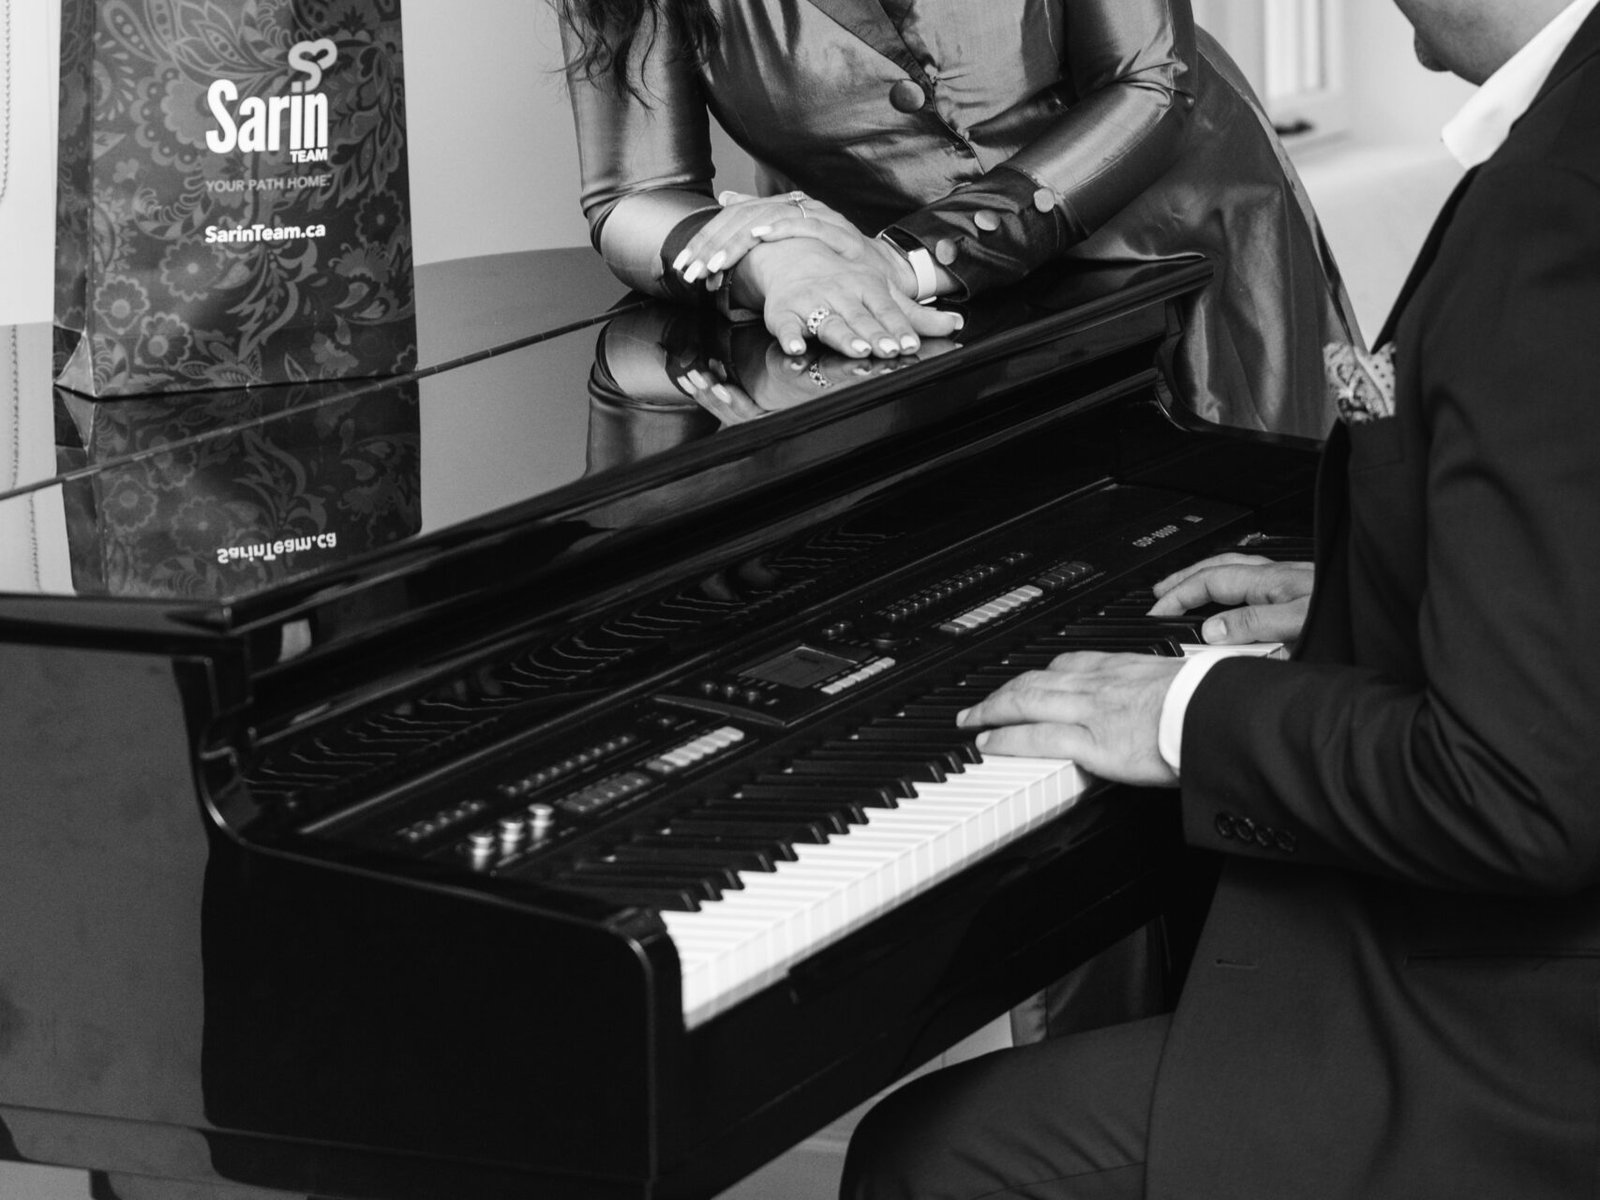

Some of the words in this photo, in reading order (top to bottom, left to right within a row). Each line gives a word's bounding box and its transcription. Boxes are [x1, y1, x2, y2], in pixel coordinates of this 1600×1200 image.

[205, 79, 329, 153] Sarin
[289, 149, 328, 163] TEAM
[205, 179, 245, 193] YOUR
[248, 177, 284, 191] PATH
[205, 224, 326, 243] SarinTeam.ca
